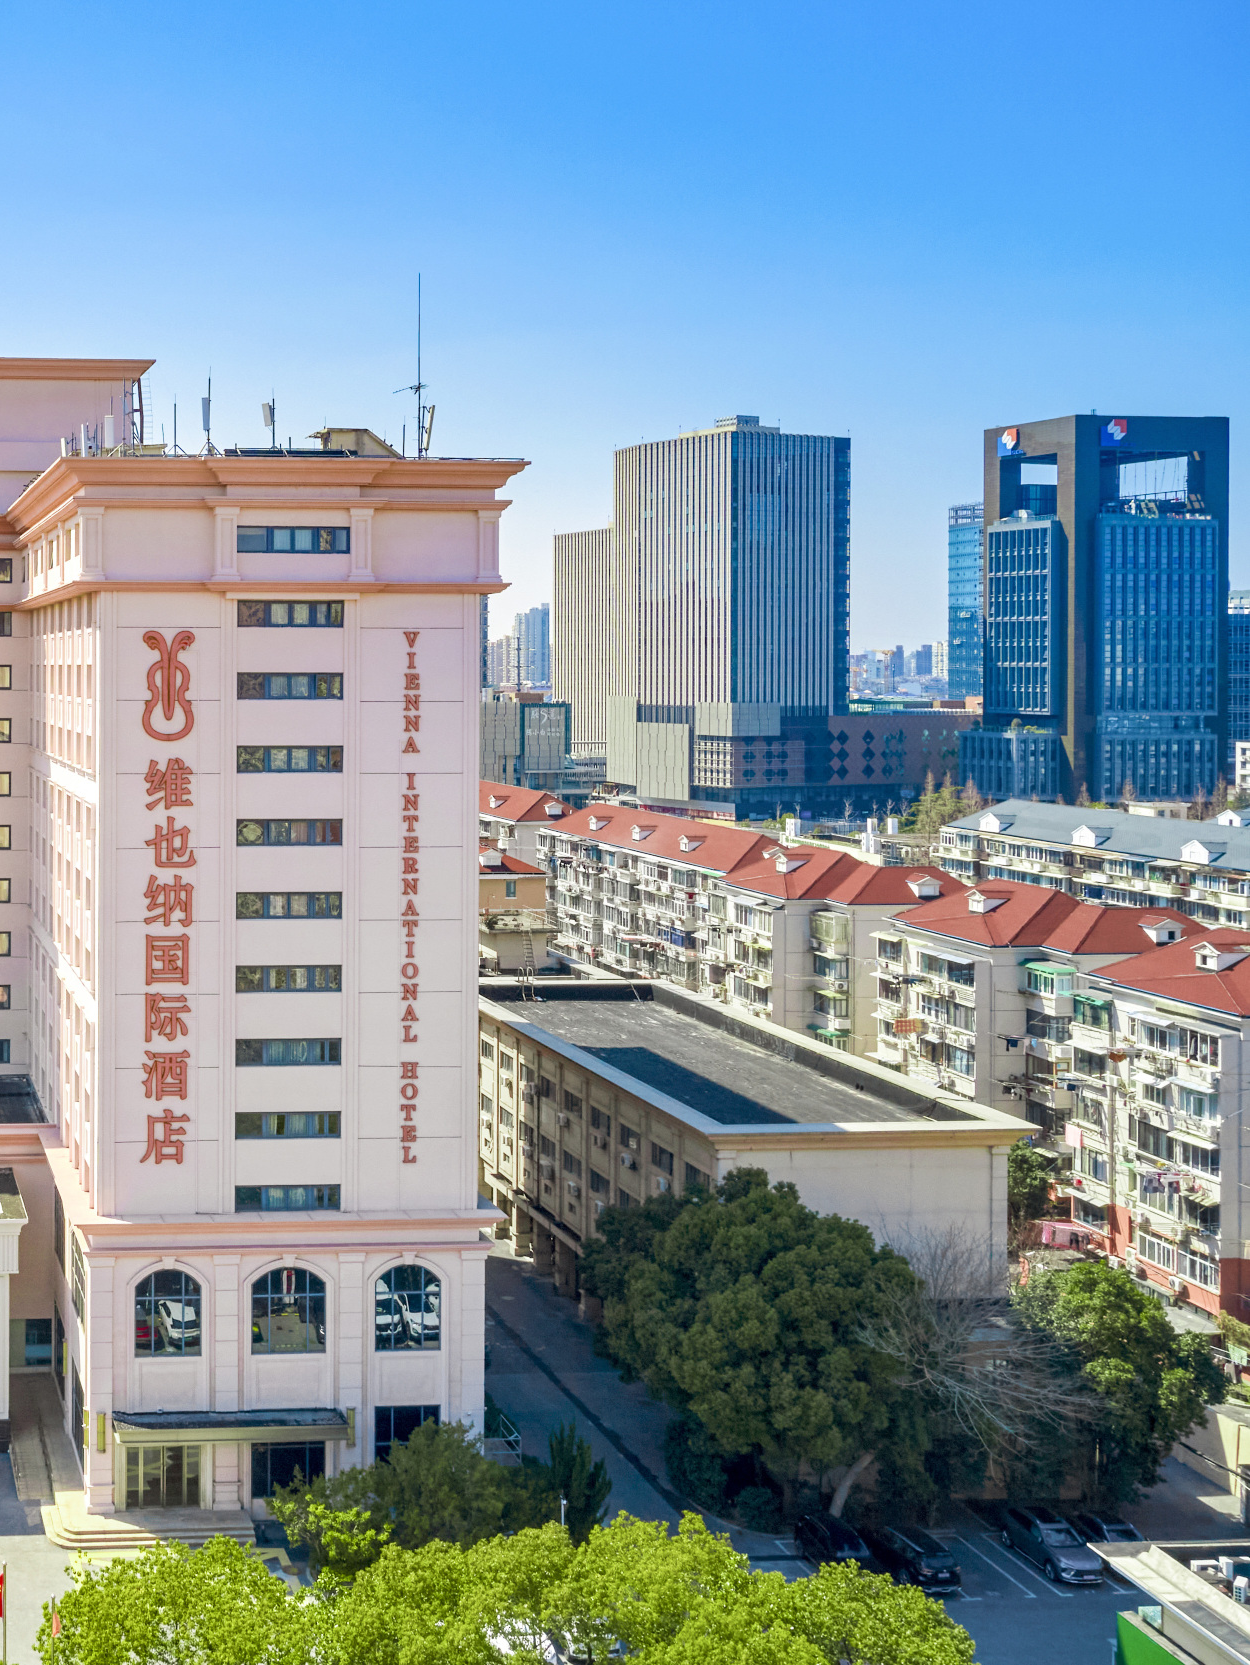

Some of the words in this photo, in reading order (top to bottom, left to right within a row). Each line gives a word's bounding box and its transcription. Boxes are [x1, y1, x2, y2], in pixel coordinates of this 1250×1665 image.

[402, 631, 421, 753] VIENNA
[139, 757, 197, 1165] 维也纳国际酒店
[401, 772, 420, 1043] INTERNATIONAL
[400, 1062, 419, 1164] HOTEL
